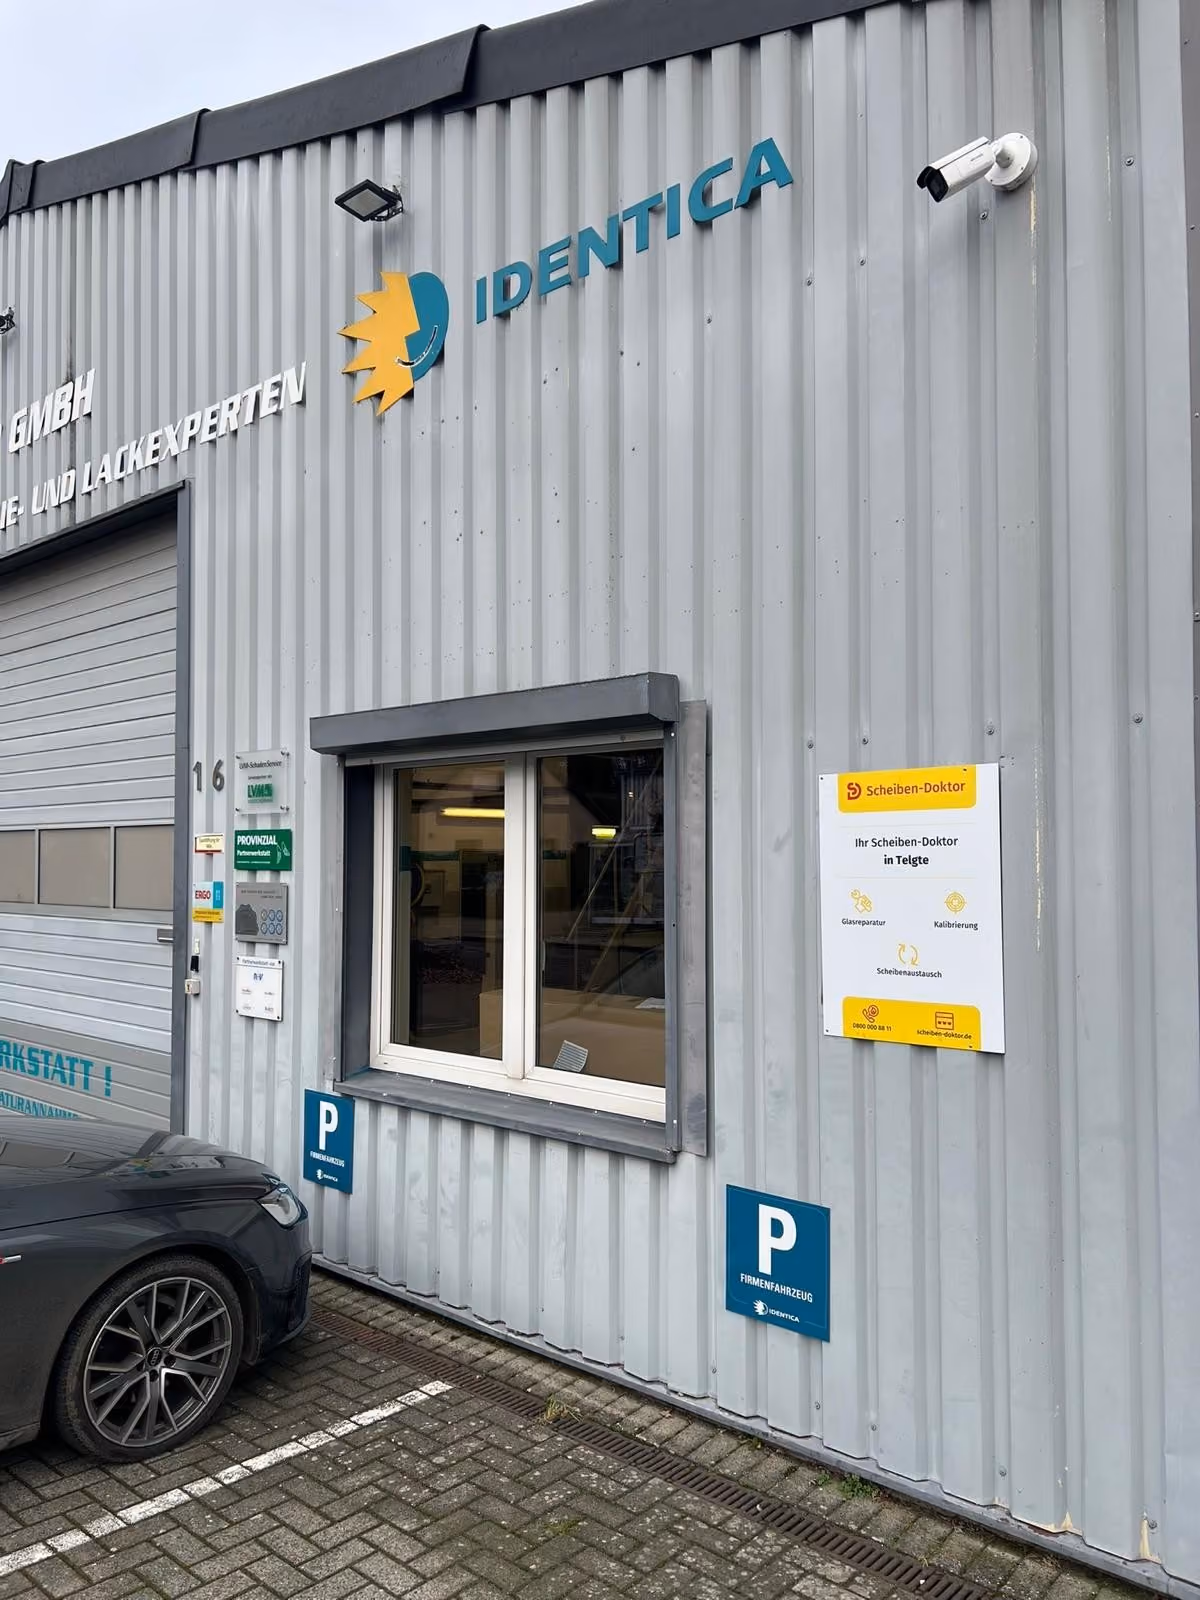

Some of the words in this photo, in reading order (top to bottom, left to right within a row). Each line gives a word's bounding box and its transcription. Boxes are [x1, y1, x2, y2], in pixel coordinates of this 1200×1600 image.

[476, 137, 794, 325] IDENTICA
[9, 368, 95, 453] GMBH
[31, 469, 76, 515] UND
[81, 361, 306, 495] LACKEXPERTEN
[866, 781, 966, 797] Scheiben-Doktor
[237, 835, 277, 846] PROVINZIAL
[855, 838, 869, 848] Ihr
[871, 836, 959, 848] Scheiben-Doktor
[883, 854, 894, 865] in
[895, 854, 930, 867] Telgte
[195, 890, 211, 900] ERGO
[841, 918, 886, 927] Glasreparatur
[934, 920, 979, 931] Kalibrierung
[876, 967, 943, 979] Scheibenaustausch
[852, 1022, 867, 1030] 0800
[916, 1029, 973, 1040] scheiben-doktor.de
[318, 1100, 338, 1151] P
[758, 1203, 797, 1276] P
[740, 1273, 813, 1304] FIRMENFAHRZEUG
[768, 1308, 800, 1323] IDENTICA
